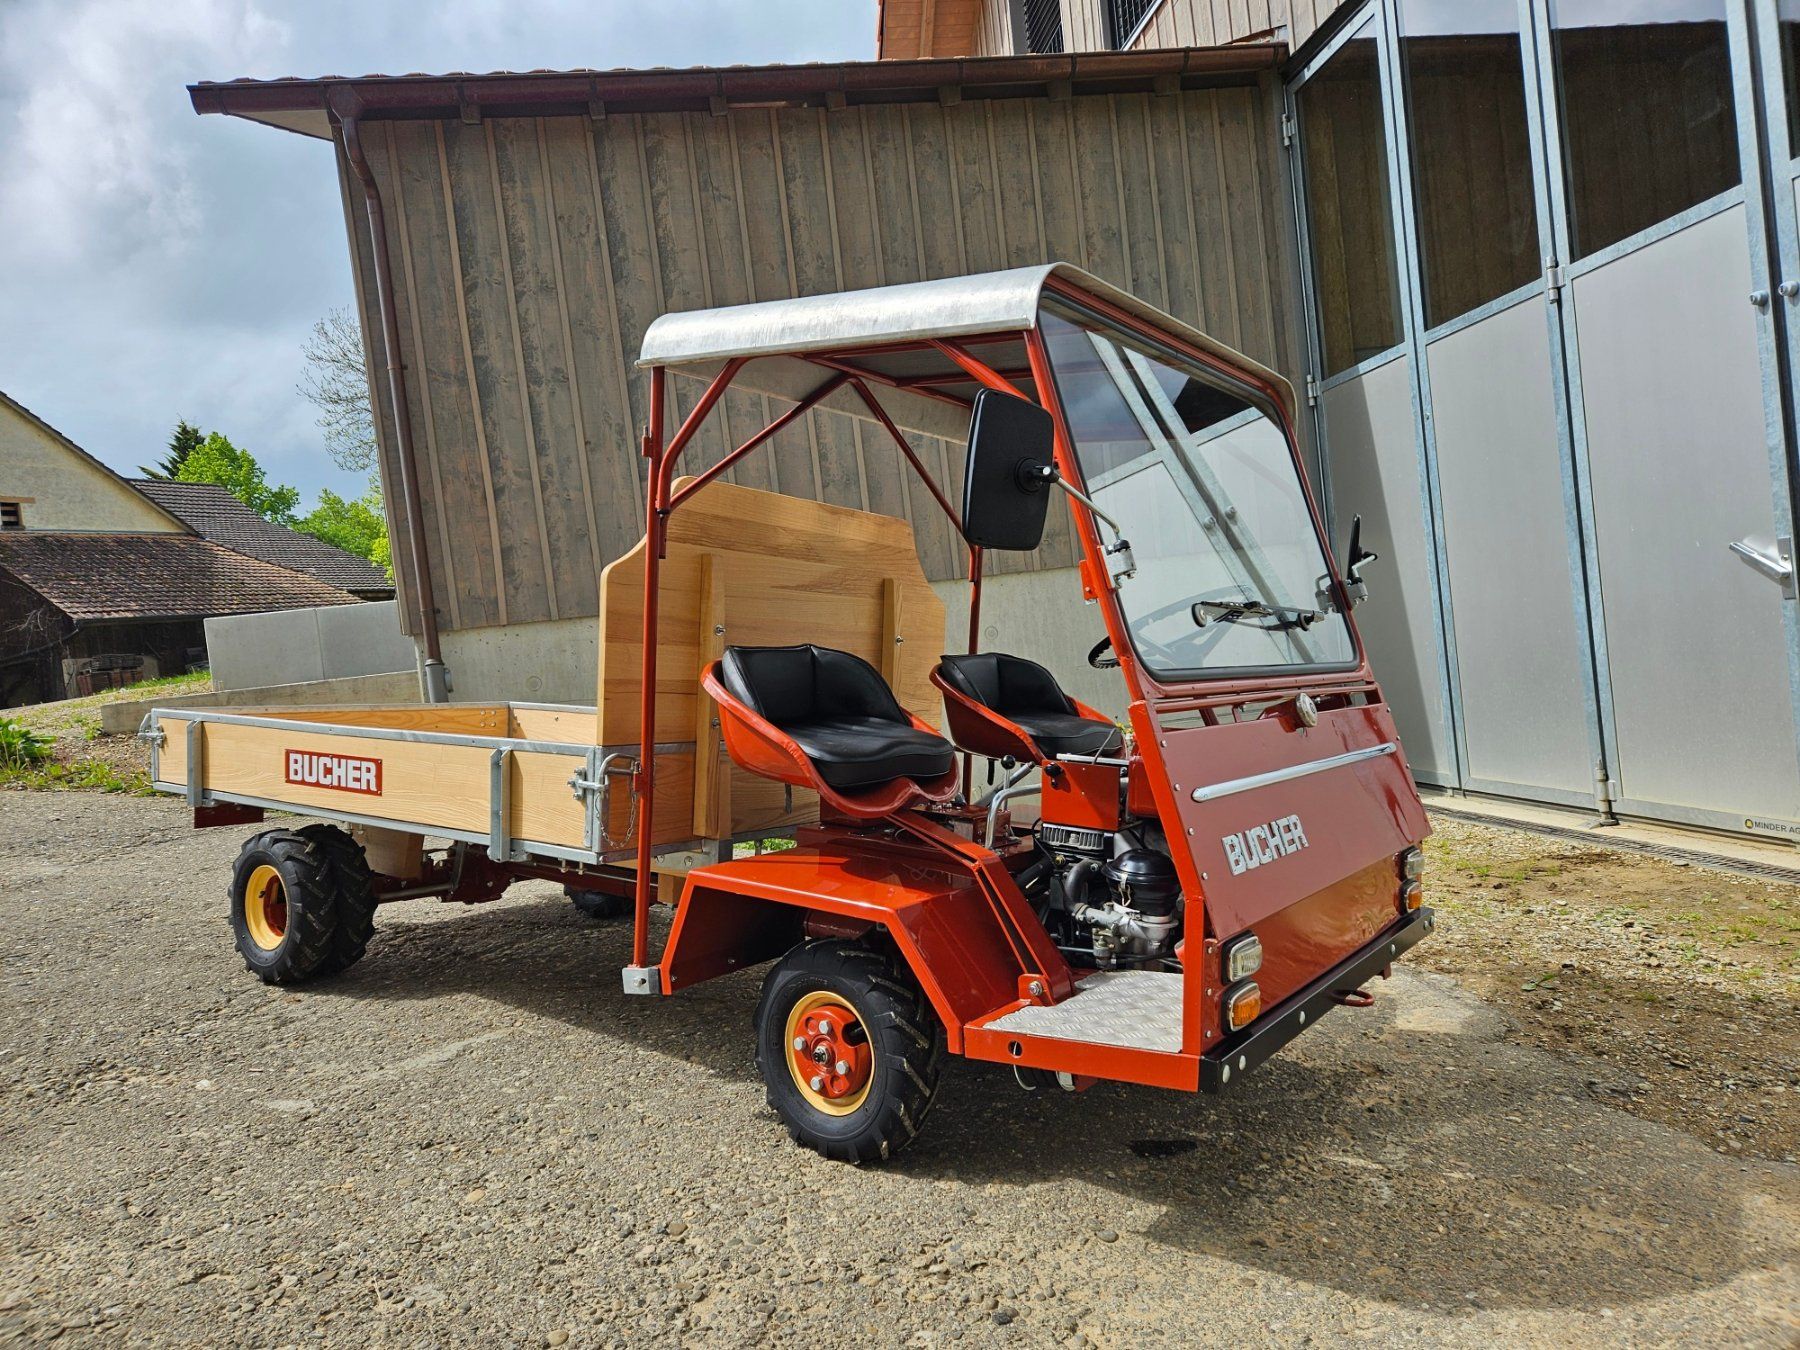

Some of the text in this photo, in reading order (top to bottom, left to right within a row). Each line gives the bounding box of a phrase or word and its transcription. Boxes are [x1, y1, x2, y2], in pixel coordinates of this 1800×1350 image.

[289, 753, 377, 791] BUCHER
[1222, 814, 1309, 876] BUCHER
[1754, 821, 1787, 832] MINDER
